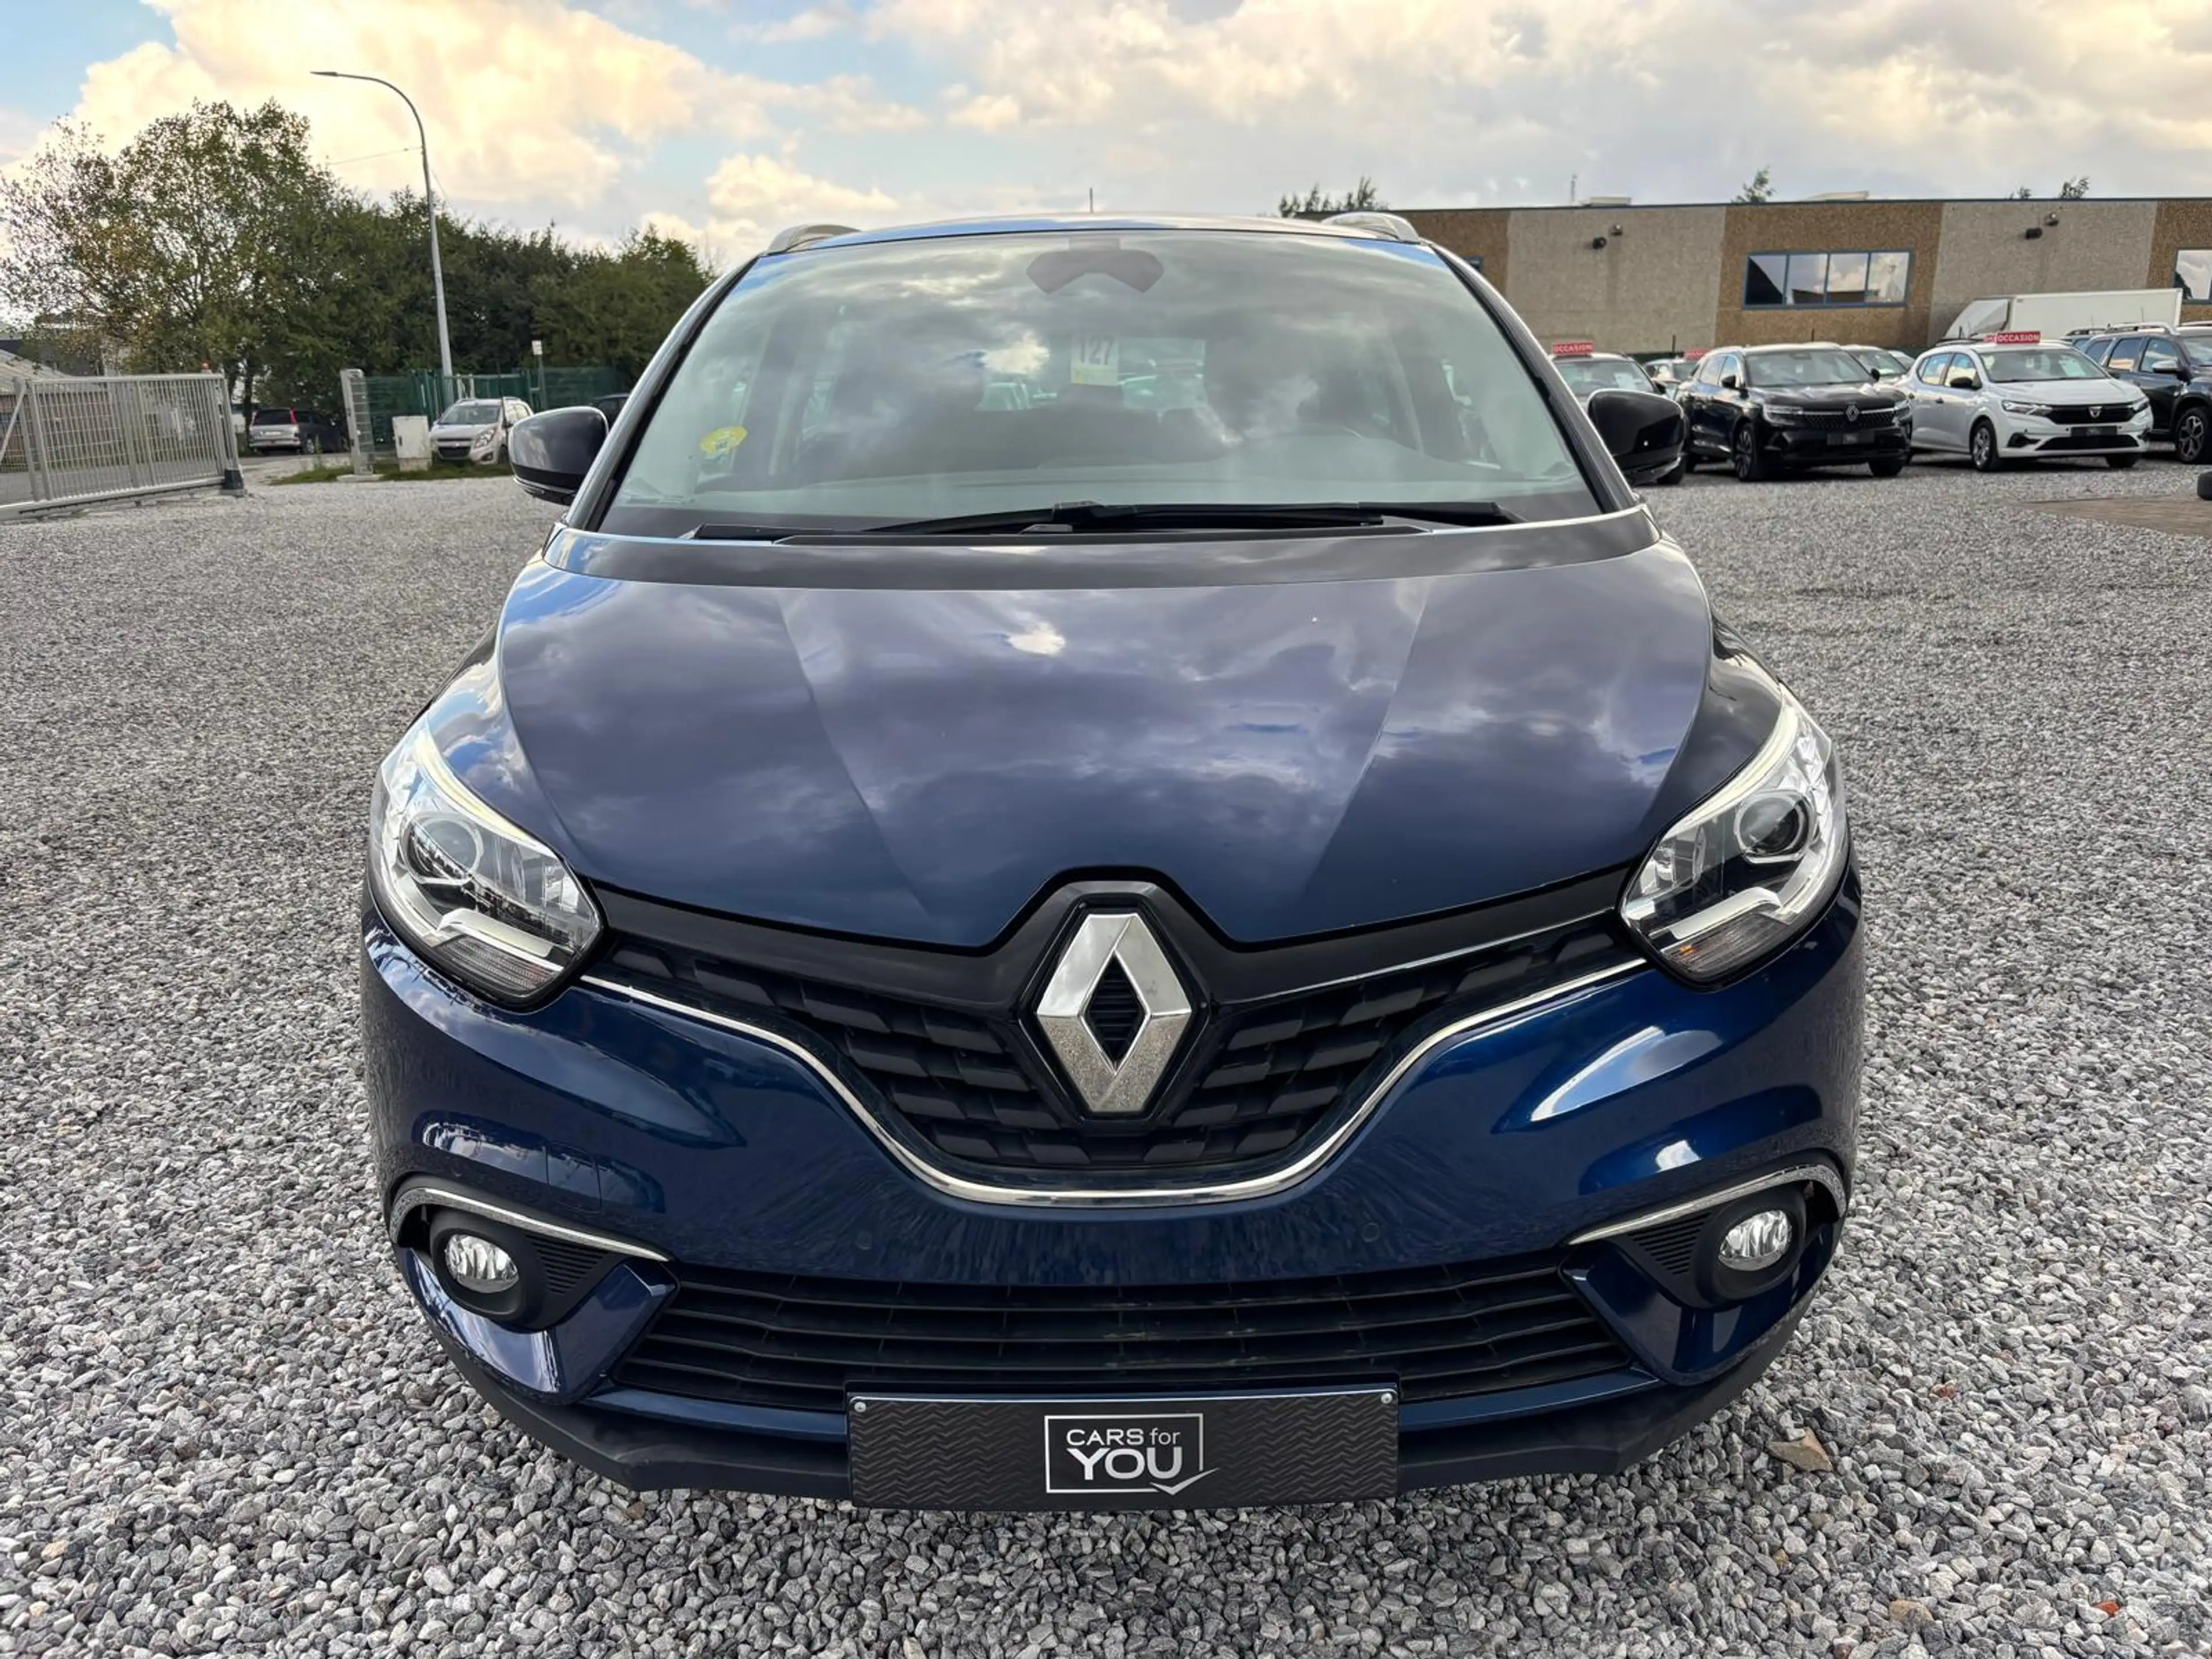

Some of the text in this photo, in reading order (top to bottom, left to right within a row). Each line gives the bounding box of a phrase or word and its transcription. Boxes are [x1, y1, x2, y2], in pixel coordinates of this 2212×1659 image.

[1080, 335, 1115, 365] 127
[1997, 334, 2040, 342] OCCASION
[1066, 1427, 1181, 1446] CARS for
[1066, 1446, 1183, 1480] YOU
